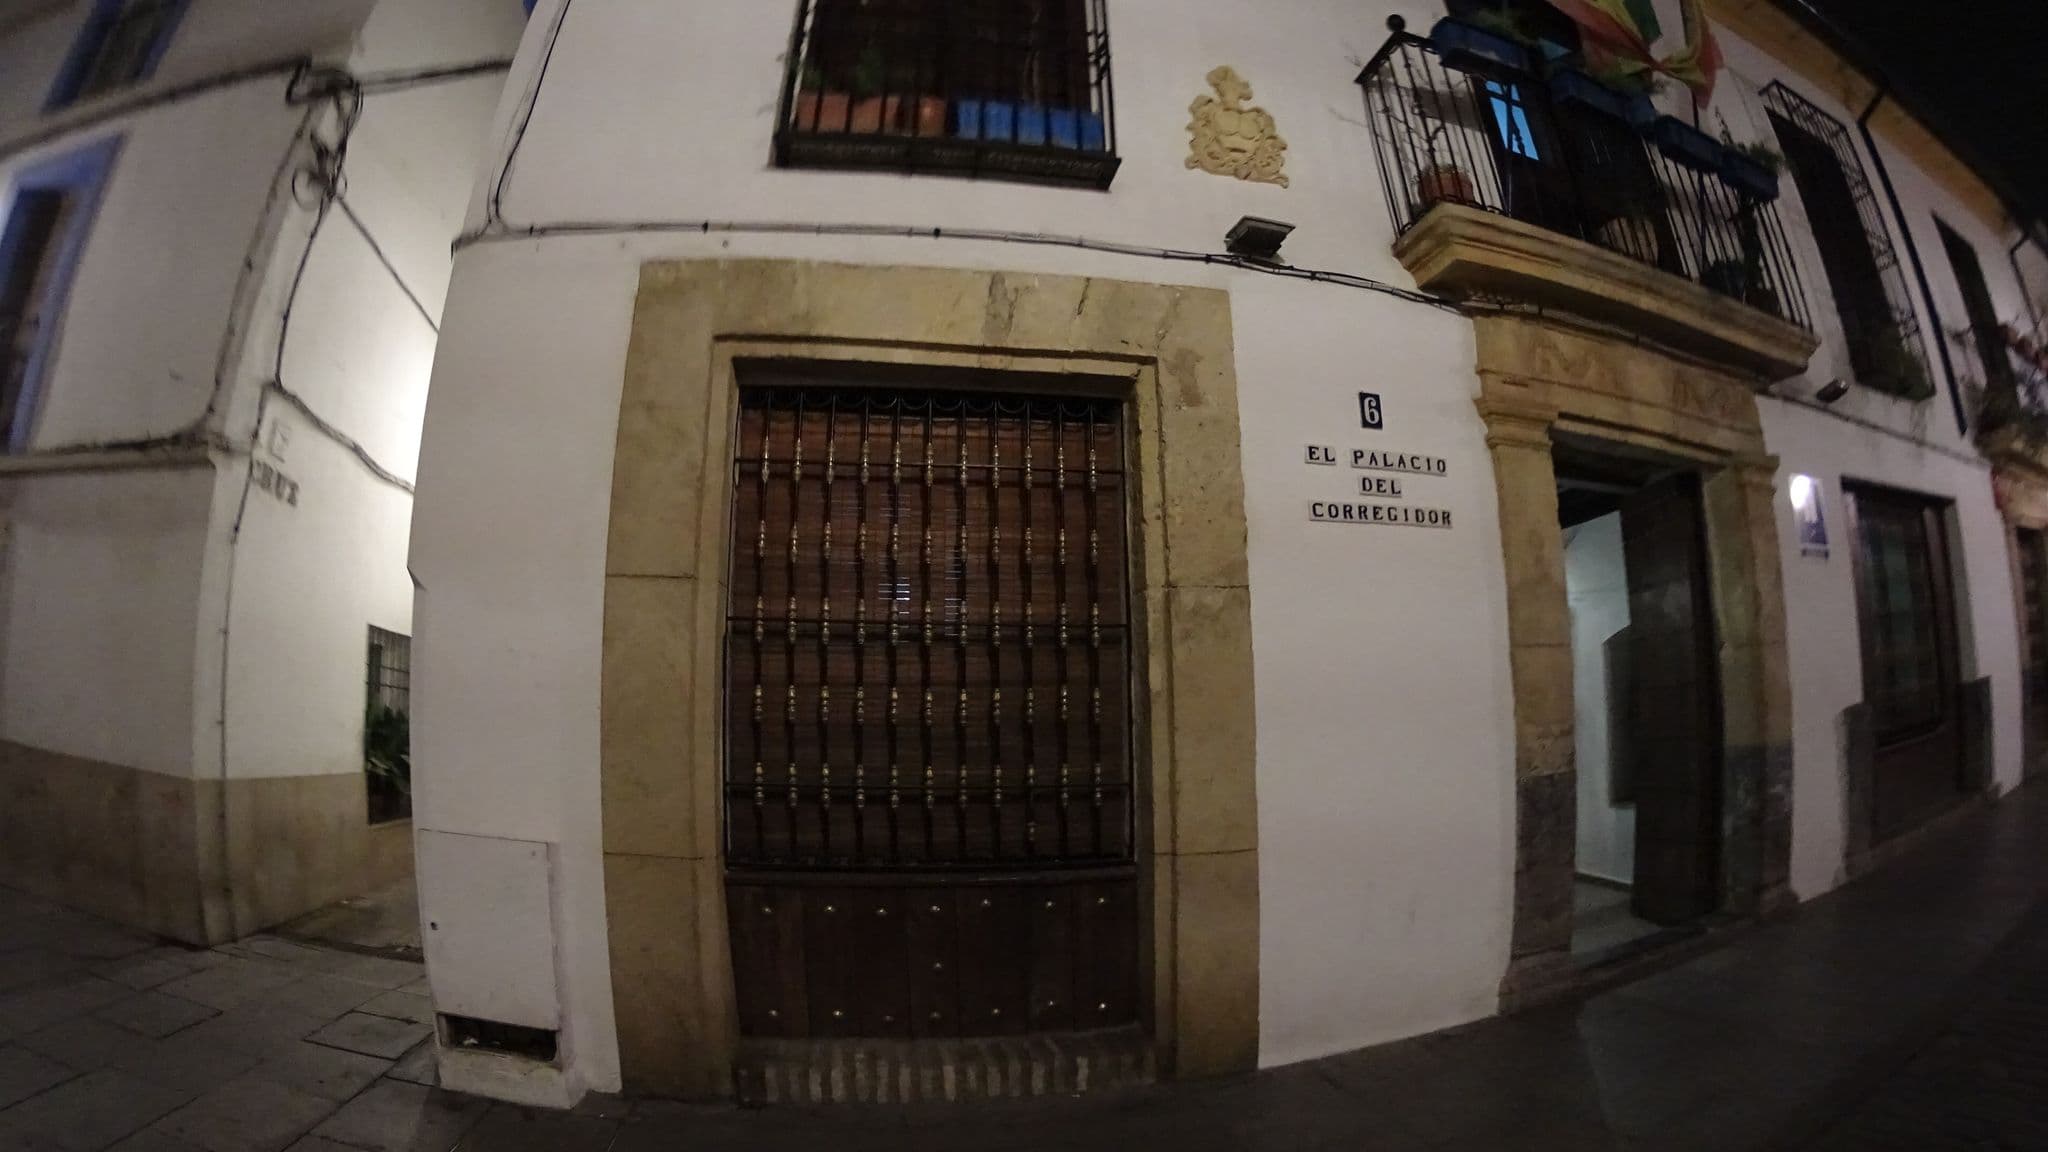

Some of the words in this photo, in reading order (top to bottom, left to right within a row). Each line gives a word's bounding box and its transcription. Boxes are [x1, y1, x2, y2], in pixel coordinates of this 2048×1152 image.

[1363, 397, 1380, 424] 6
[1308, 446, 1335, 462] EL
[1353, 450, 1447, 473] PALACIO
[1361, 477, 1401, 494] DEL
[1312, 502, 1450, 526] CORREGIDOR
